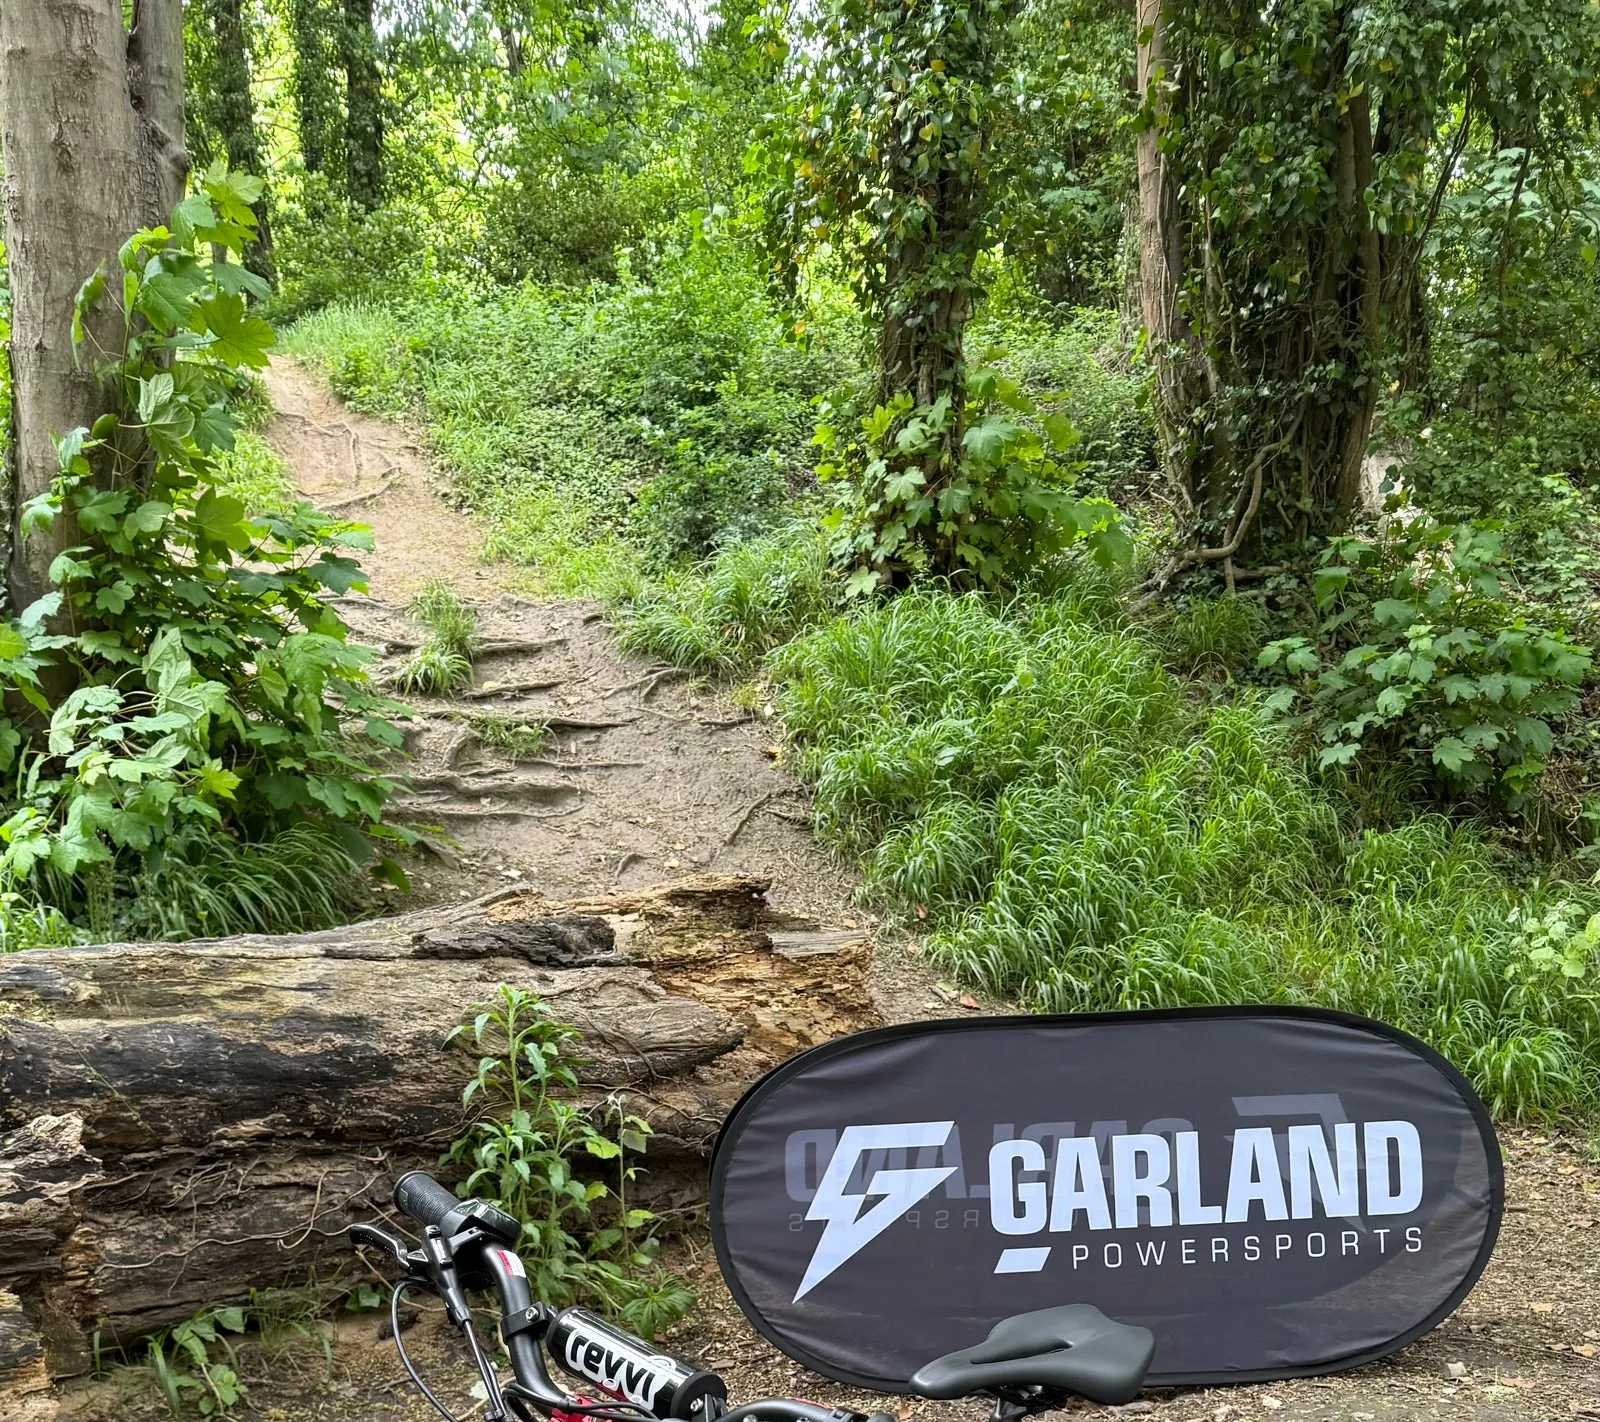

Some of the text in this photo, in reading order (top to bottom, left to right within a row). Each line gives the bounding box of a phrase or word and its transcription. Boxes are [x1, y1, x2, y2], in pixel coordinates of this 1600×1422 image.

[988, 1120, 1423, 1236] GARLAND
[1072, 1226, 1423, 1270] POWERSPORTS
[568, 1332, 667, 1404] revvi
